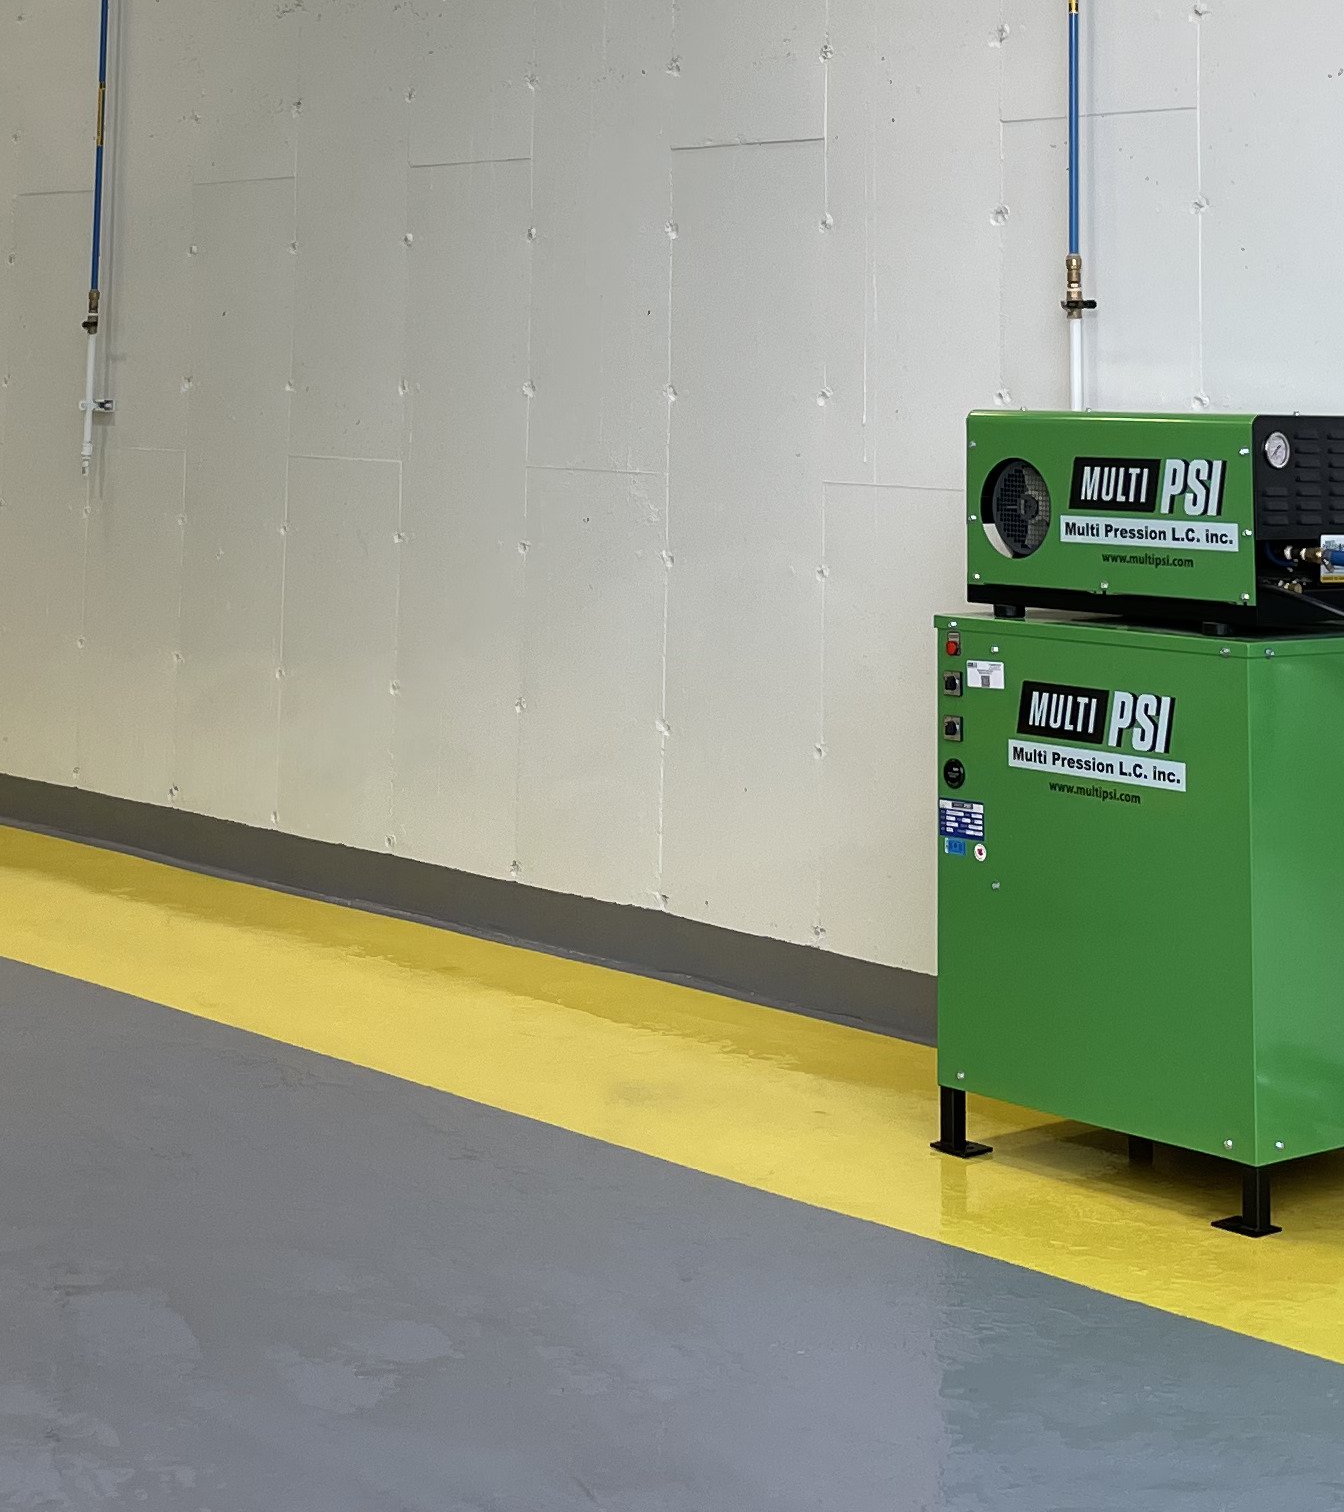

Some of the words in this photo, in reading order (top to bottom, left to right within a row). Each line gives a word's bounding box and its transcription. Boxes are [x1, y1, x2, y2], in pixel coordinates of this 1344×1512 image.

[1080, 466, 1149, 503] MULTI
[1160, 458, 1227, 516] PSI
[1064, 522, 1099, 538] Multi
[1104, 524, 1167, 541] Pression
[1171, 527, 1201, 543] L.C.
[1205, 529, 1233, 544] inc.
[1102, 553, 1194, 568] www.multipsi.com
[1028, 691, 1097, 734] MULTI
[1108, 690, 1176, 754] PSI
[1012, 746, 1047, 765] Multi
[1051, 752, 1114, 775] Pression
[1119, 761, 1148, 779] L.C.
[1152, 766, 1181, 784] inc.
[1049, 781, 1141, 804] www.multipsi.com
